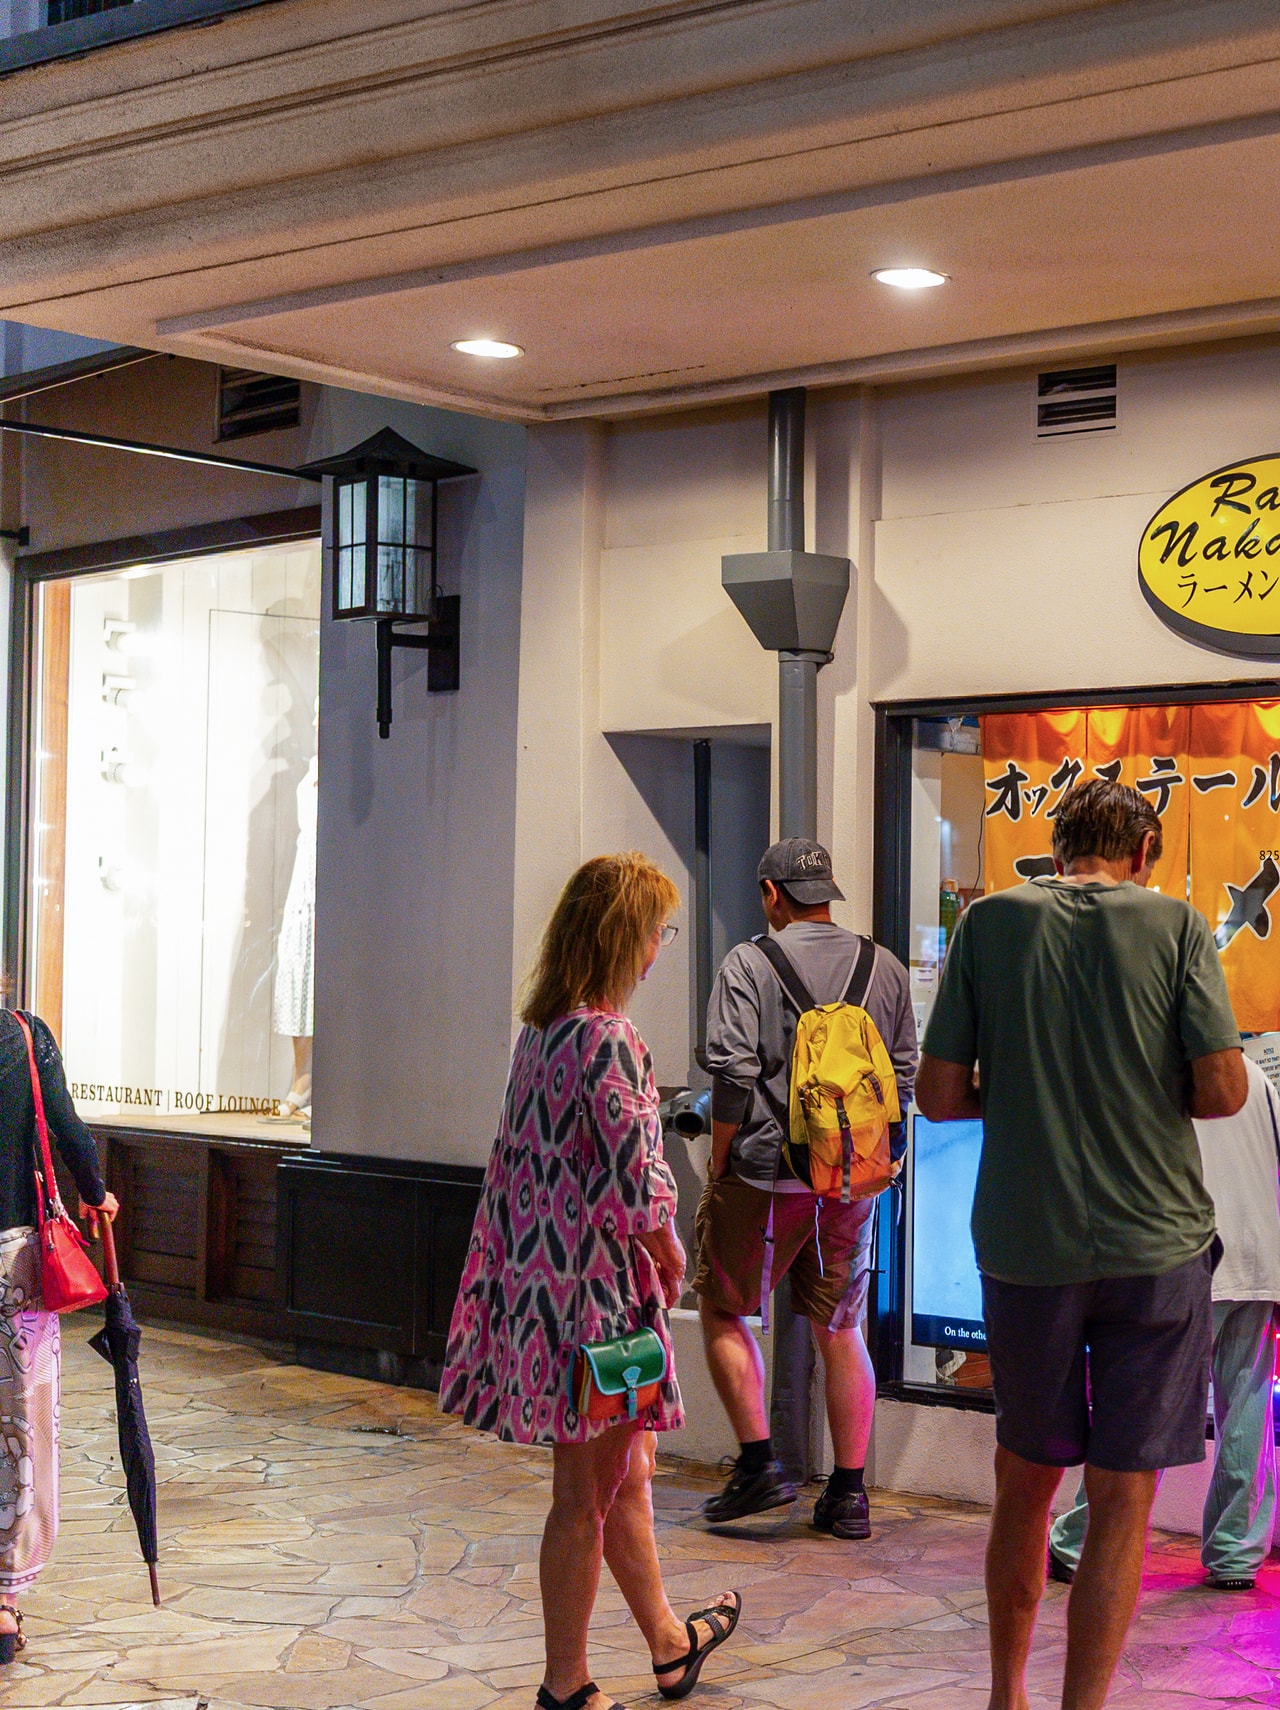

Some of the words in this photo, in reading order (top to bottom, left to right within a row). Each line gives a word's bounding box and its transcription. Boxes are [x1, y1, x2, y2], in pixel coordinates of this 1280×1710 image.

[71, 1082, 163, 1106] RESTAURANT
[174, 1091, 214, 1111] ROOF
[218, 1094, 281, 1116] LOUNGE
[944, 1326, 956, 1336] On
[958, 1327, 970, 1338] the
